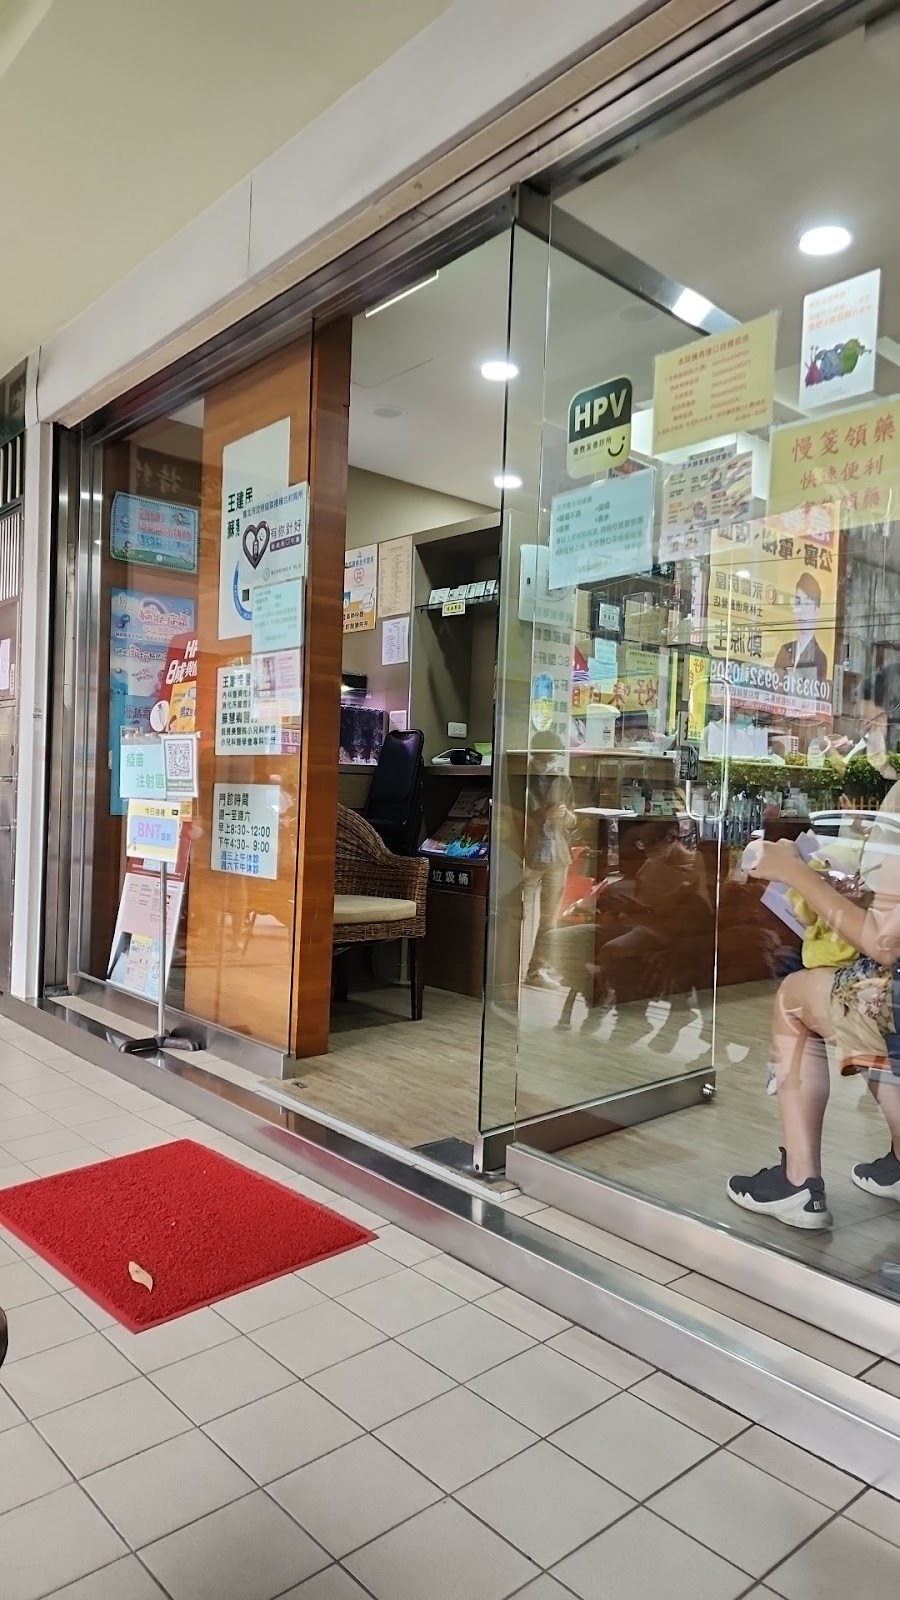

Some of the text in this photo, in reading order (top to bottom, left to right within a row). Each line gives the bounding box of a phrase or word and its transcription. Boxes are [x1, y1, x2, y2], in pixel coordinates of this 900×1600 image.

[574, 388, 627, 433] HPV
[792, 414, 896, 463] 慢箋領藥
[799, 454, 884, 491] 快速便利
[271, 519, 302, 539] 有你針好
[126, 752, 144, 767] 疫苗
[136, 774, 165, 789] 注射區
[218, 793, 249, 807] 門診時間
[145, 807, 166, 816] 今日接種
[218, 808, 251, 822] 週一至週六
[137, 822, 162, 839] BNT
[218, 822, 270, 838] 早上8:30~12:00
[220, 850, 260, 864] 週三上午休診
[220, 860, 260, 874] 週六下午休診
[432, 869, 469, 886] 垃圾桶
